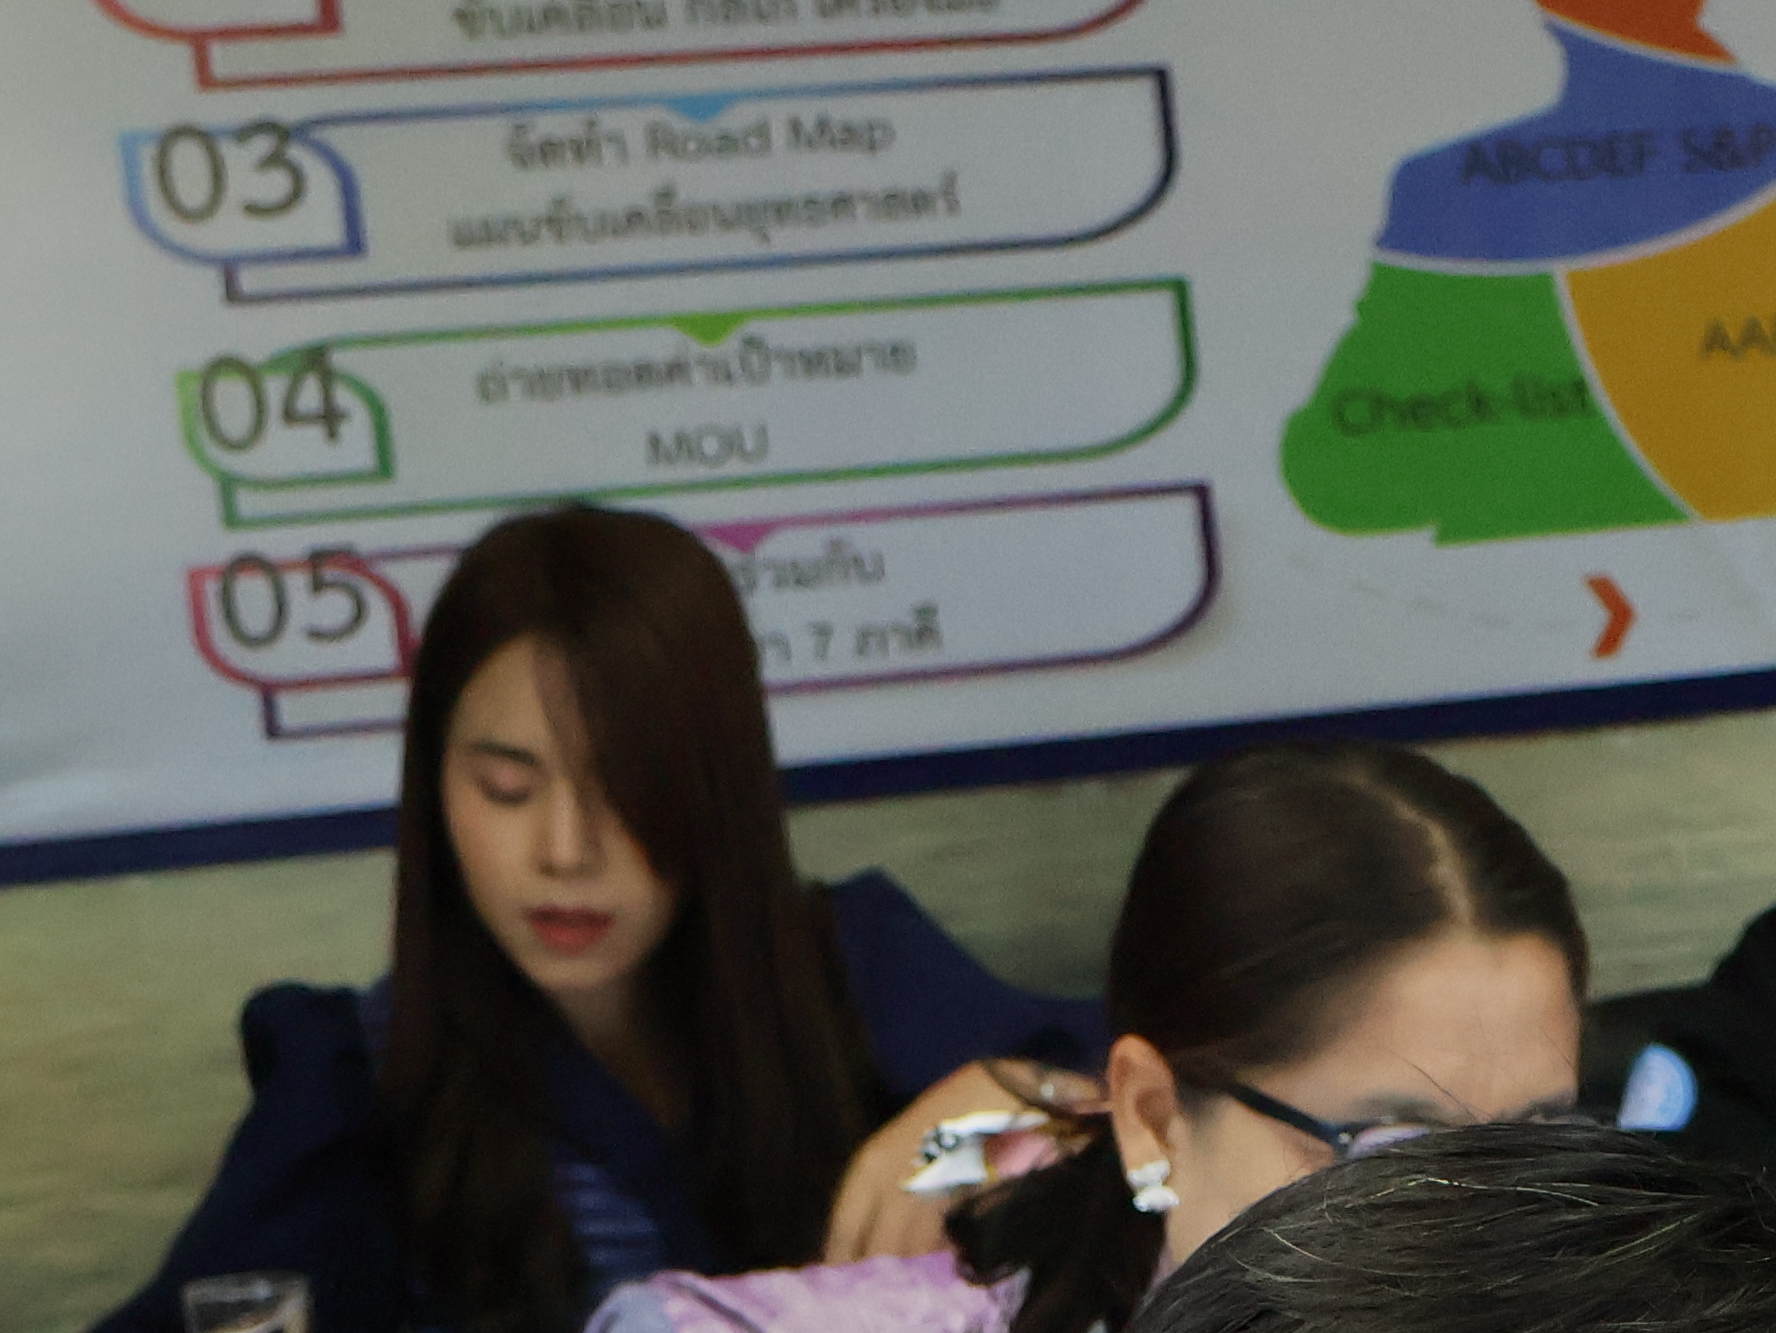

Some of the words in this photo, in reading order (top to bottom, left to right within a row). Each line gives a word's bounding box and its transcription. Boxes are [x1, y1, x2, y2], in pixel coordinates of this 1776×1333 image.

[154, 121, 306, 222] 03
[643, 116, 774, 162] Road
[784, 111, 896, 156] Map
[1458, 128, 1656, 186] ABCDEF
[200, 345, 350, 453] 04
[645, 422, 772, 468] MOU
[220, 543, 370, 648] 05
